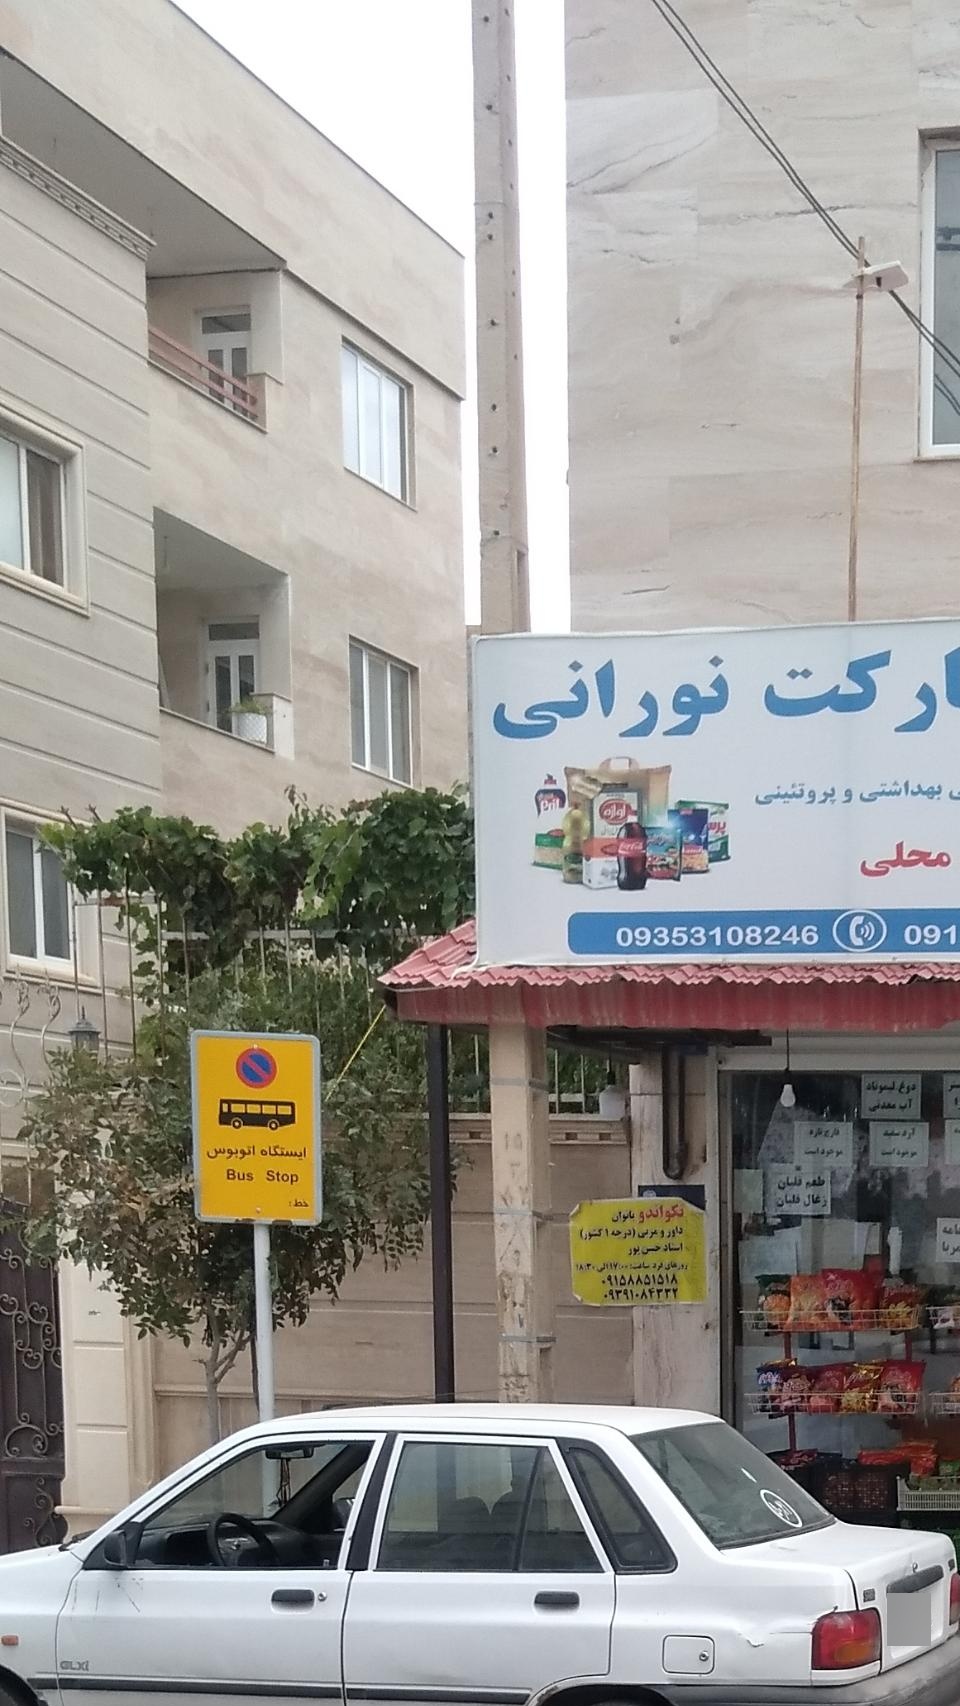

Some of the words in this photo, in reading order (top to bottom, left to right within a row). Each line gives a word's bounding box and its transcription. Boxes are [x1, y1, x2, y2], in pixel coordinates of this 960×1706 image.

[493, 655, 729, 739] نورانی
[755, 783, 836, 805] پروتئینی
[844, 787, 853, 803] و
[859, 780, 942, 802] بهداشتی
[860, 840, 952, 876] محلی
[615, 925, 819, 947] 09353108246
[206, 1145, 256, 1160] اتوبوس
[260, 1146, 307, 1161] ایستگاه
[226, 1168, 254, 1182] Bus
[265, 1170, 299, 1185] Stop
[638, 1204, 684, 1224] تکواندو
[663, 1242, 683, 1252] استاد
[602, 1274, 678, 1286] ۰۹۱۵۸۸۵۱۵۱۸
